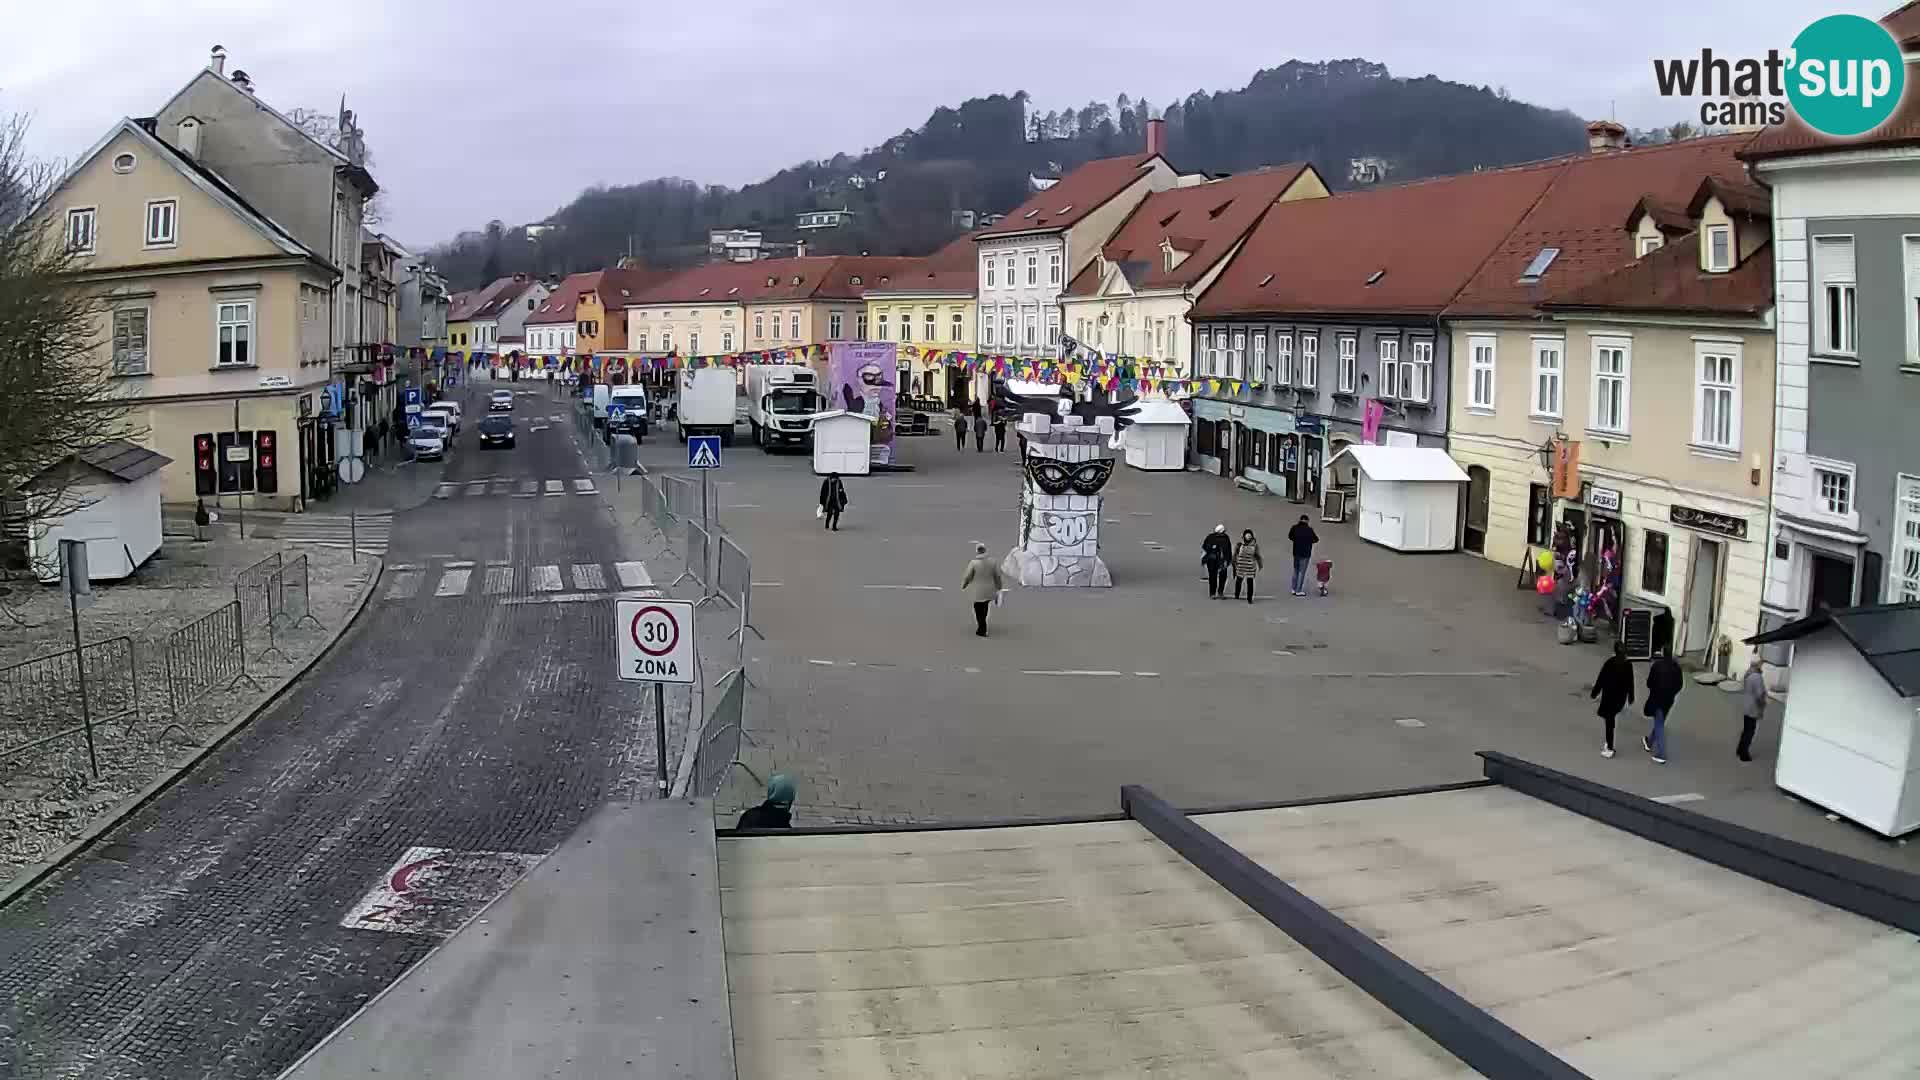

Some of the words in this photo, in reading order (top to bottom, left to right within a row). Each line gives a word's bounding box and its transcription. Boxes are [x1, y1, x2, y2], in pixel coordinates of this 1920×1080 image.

[409, 391, 416, 402] P
[644, 622, 668, 643] 30
[634, 659, 678, 676] ZONA
